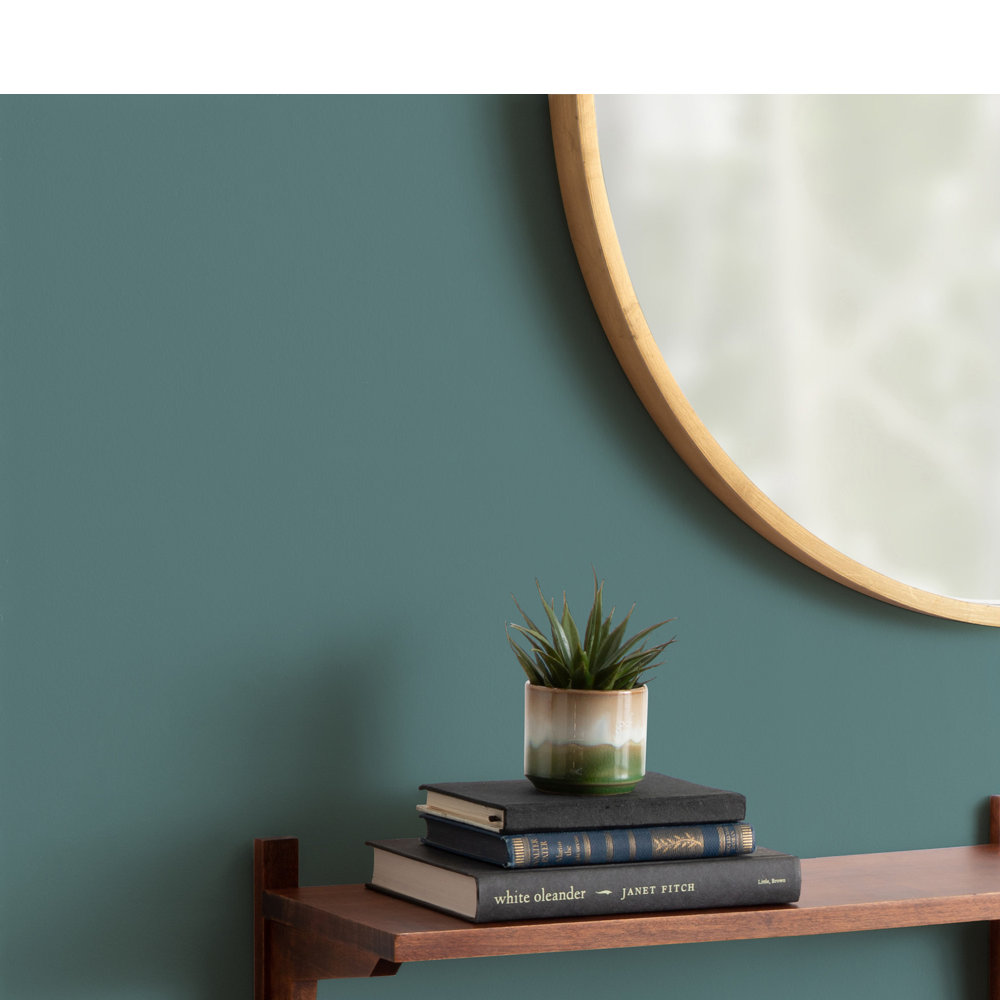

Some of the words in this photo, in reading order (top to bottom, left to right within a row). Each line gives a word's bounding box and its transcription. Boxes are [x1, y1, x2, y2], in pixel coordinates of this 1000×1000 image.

[494, 889, 530, 904] white
[533, 885, 586, 903] oleander
[620, 885, 656, 900] JANET
[661, 882, 695, 894] FITCH
